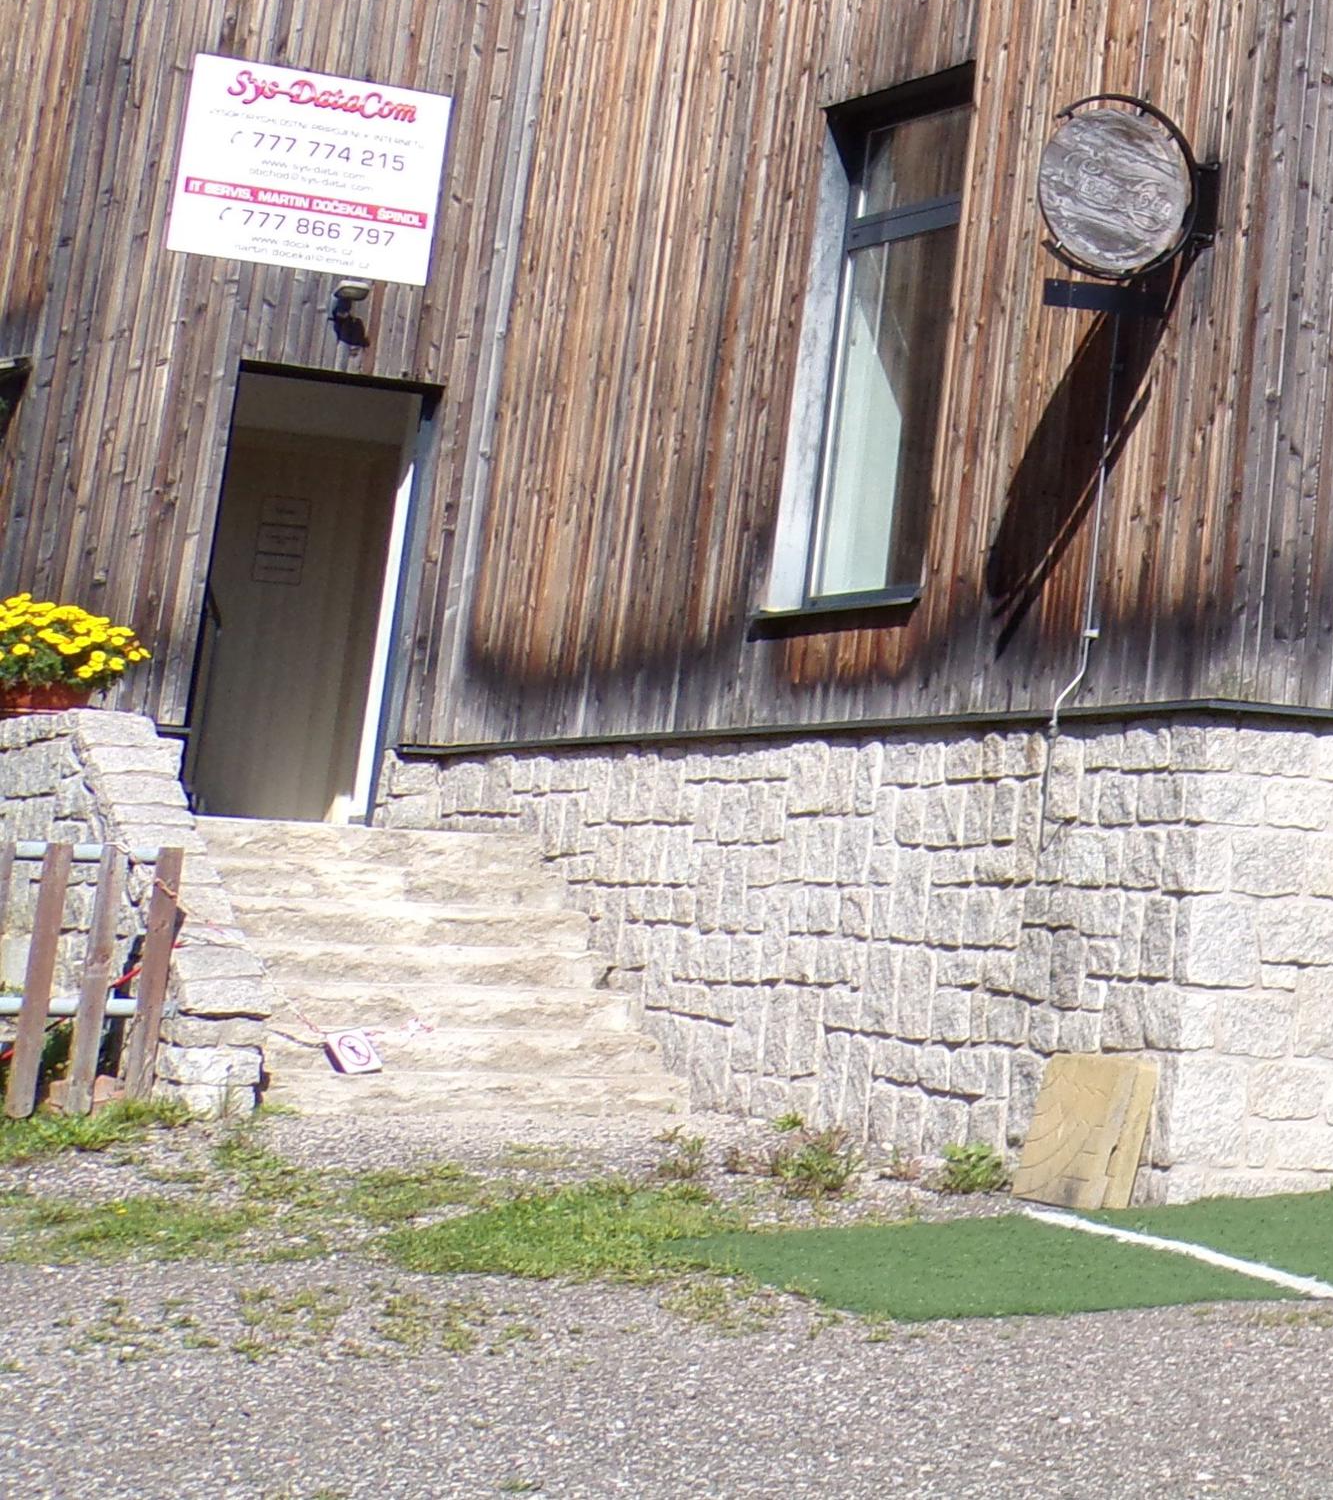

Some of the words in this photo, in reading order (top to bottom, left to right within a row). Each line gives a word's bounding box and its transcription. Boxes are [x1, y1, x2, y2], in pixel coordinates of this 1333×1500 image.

[227, 70, 417, 124] Sys-DataCom
[253, 131, 297, 153] 777
[308, 140, 351, 163] 774
[360, 149, 405, 172] 215
[188, 180, 204, 193] IT
[257, 190, 310, 209] MARTIN
[242, 209, 286, 230] 777
[296, 217, 341, 240] 866
[352, 225, 395, 247] 797
